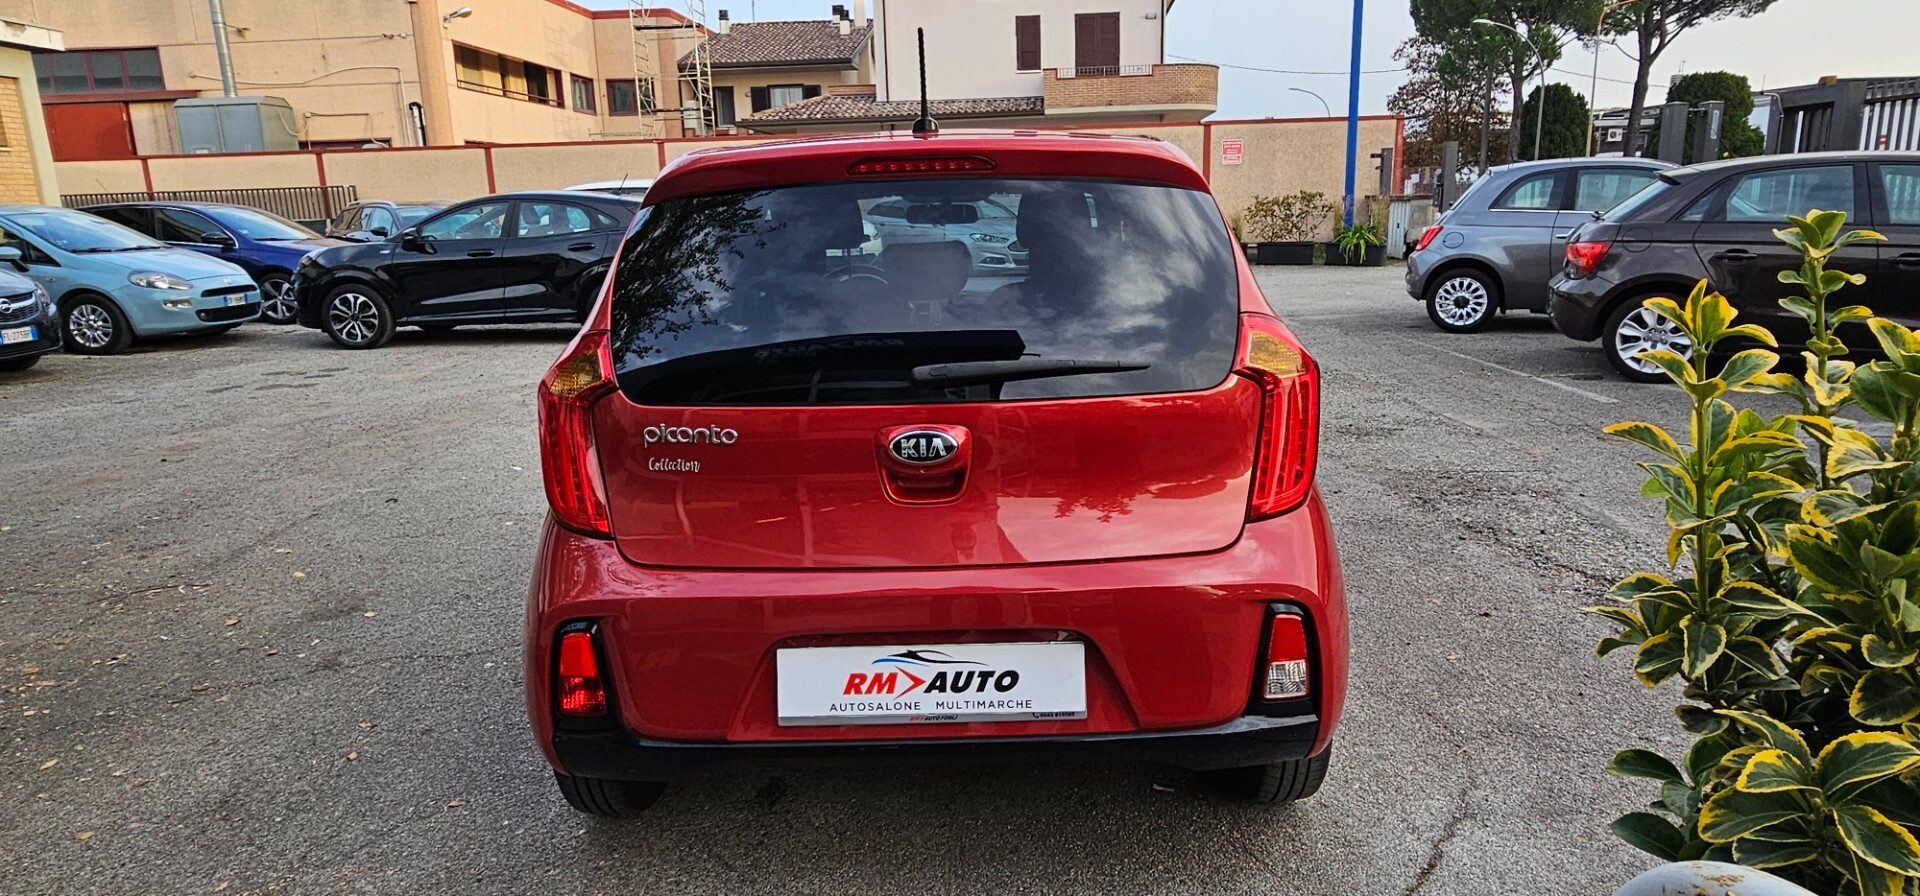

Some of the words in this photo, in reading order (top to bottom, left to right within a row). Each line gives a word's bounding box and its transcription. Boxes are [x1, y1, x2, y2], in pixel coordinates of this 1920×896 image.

[643, 423, 739, 448] picanto
[900, 438, 947, 457] KIA
[648, 457, 701, 473] Collection
[923, 670, 1020, 694] AUTO
[829, 701, 922, 713] AUTOSALONE
[936, 699, 1033, 711] MULTIMARCHE
